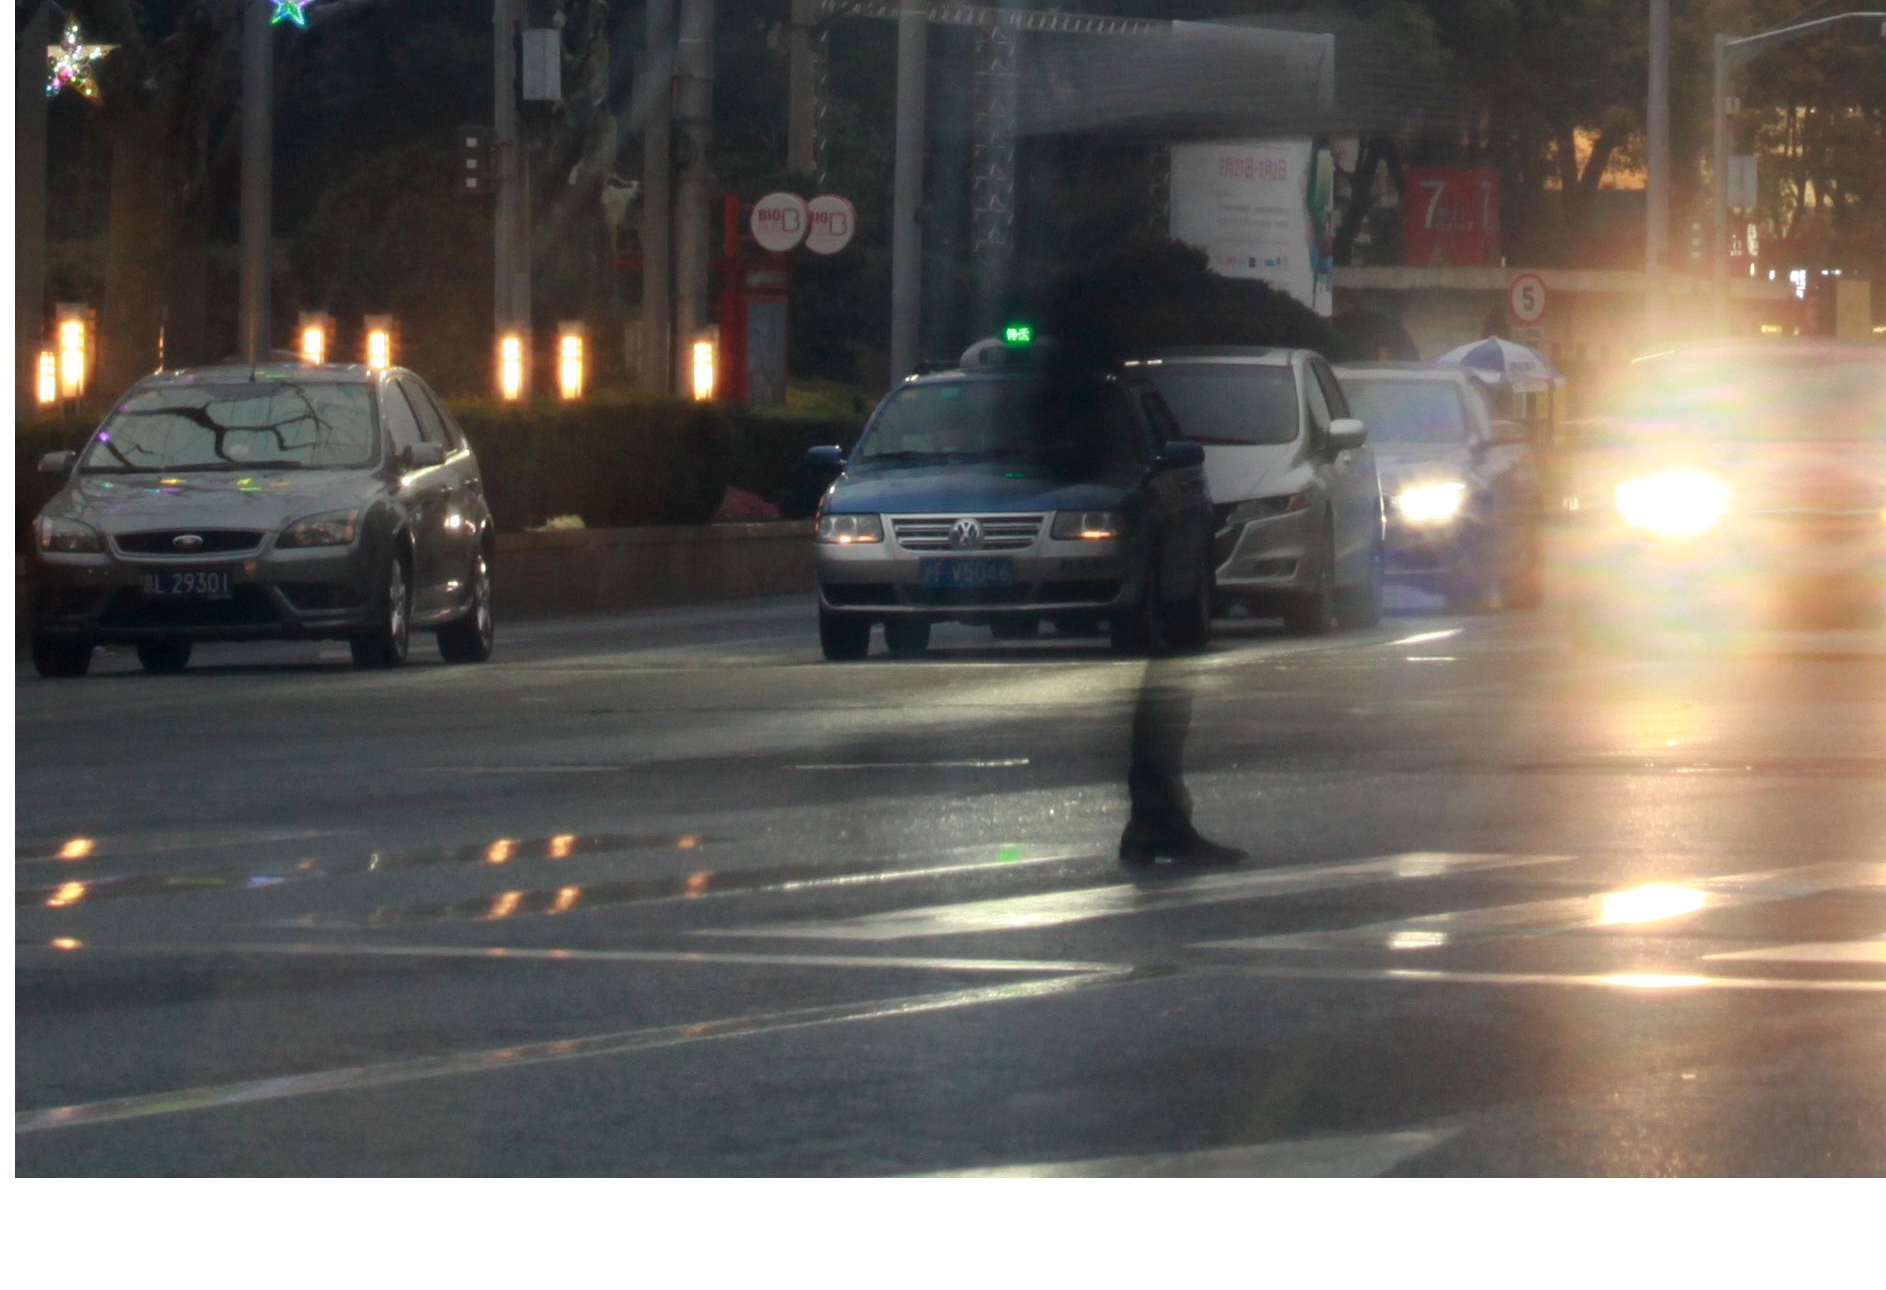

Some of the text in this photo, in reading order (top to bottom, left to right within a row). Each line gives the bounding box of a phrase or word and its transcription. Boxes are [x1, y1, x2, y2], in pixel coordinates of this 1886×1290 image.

[758, 209, 782, 221] BIG
[1522, 286, 1534, 311] 5
[171, 572, 228, 594] 29301
